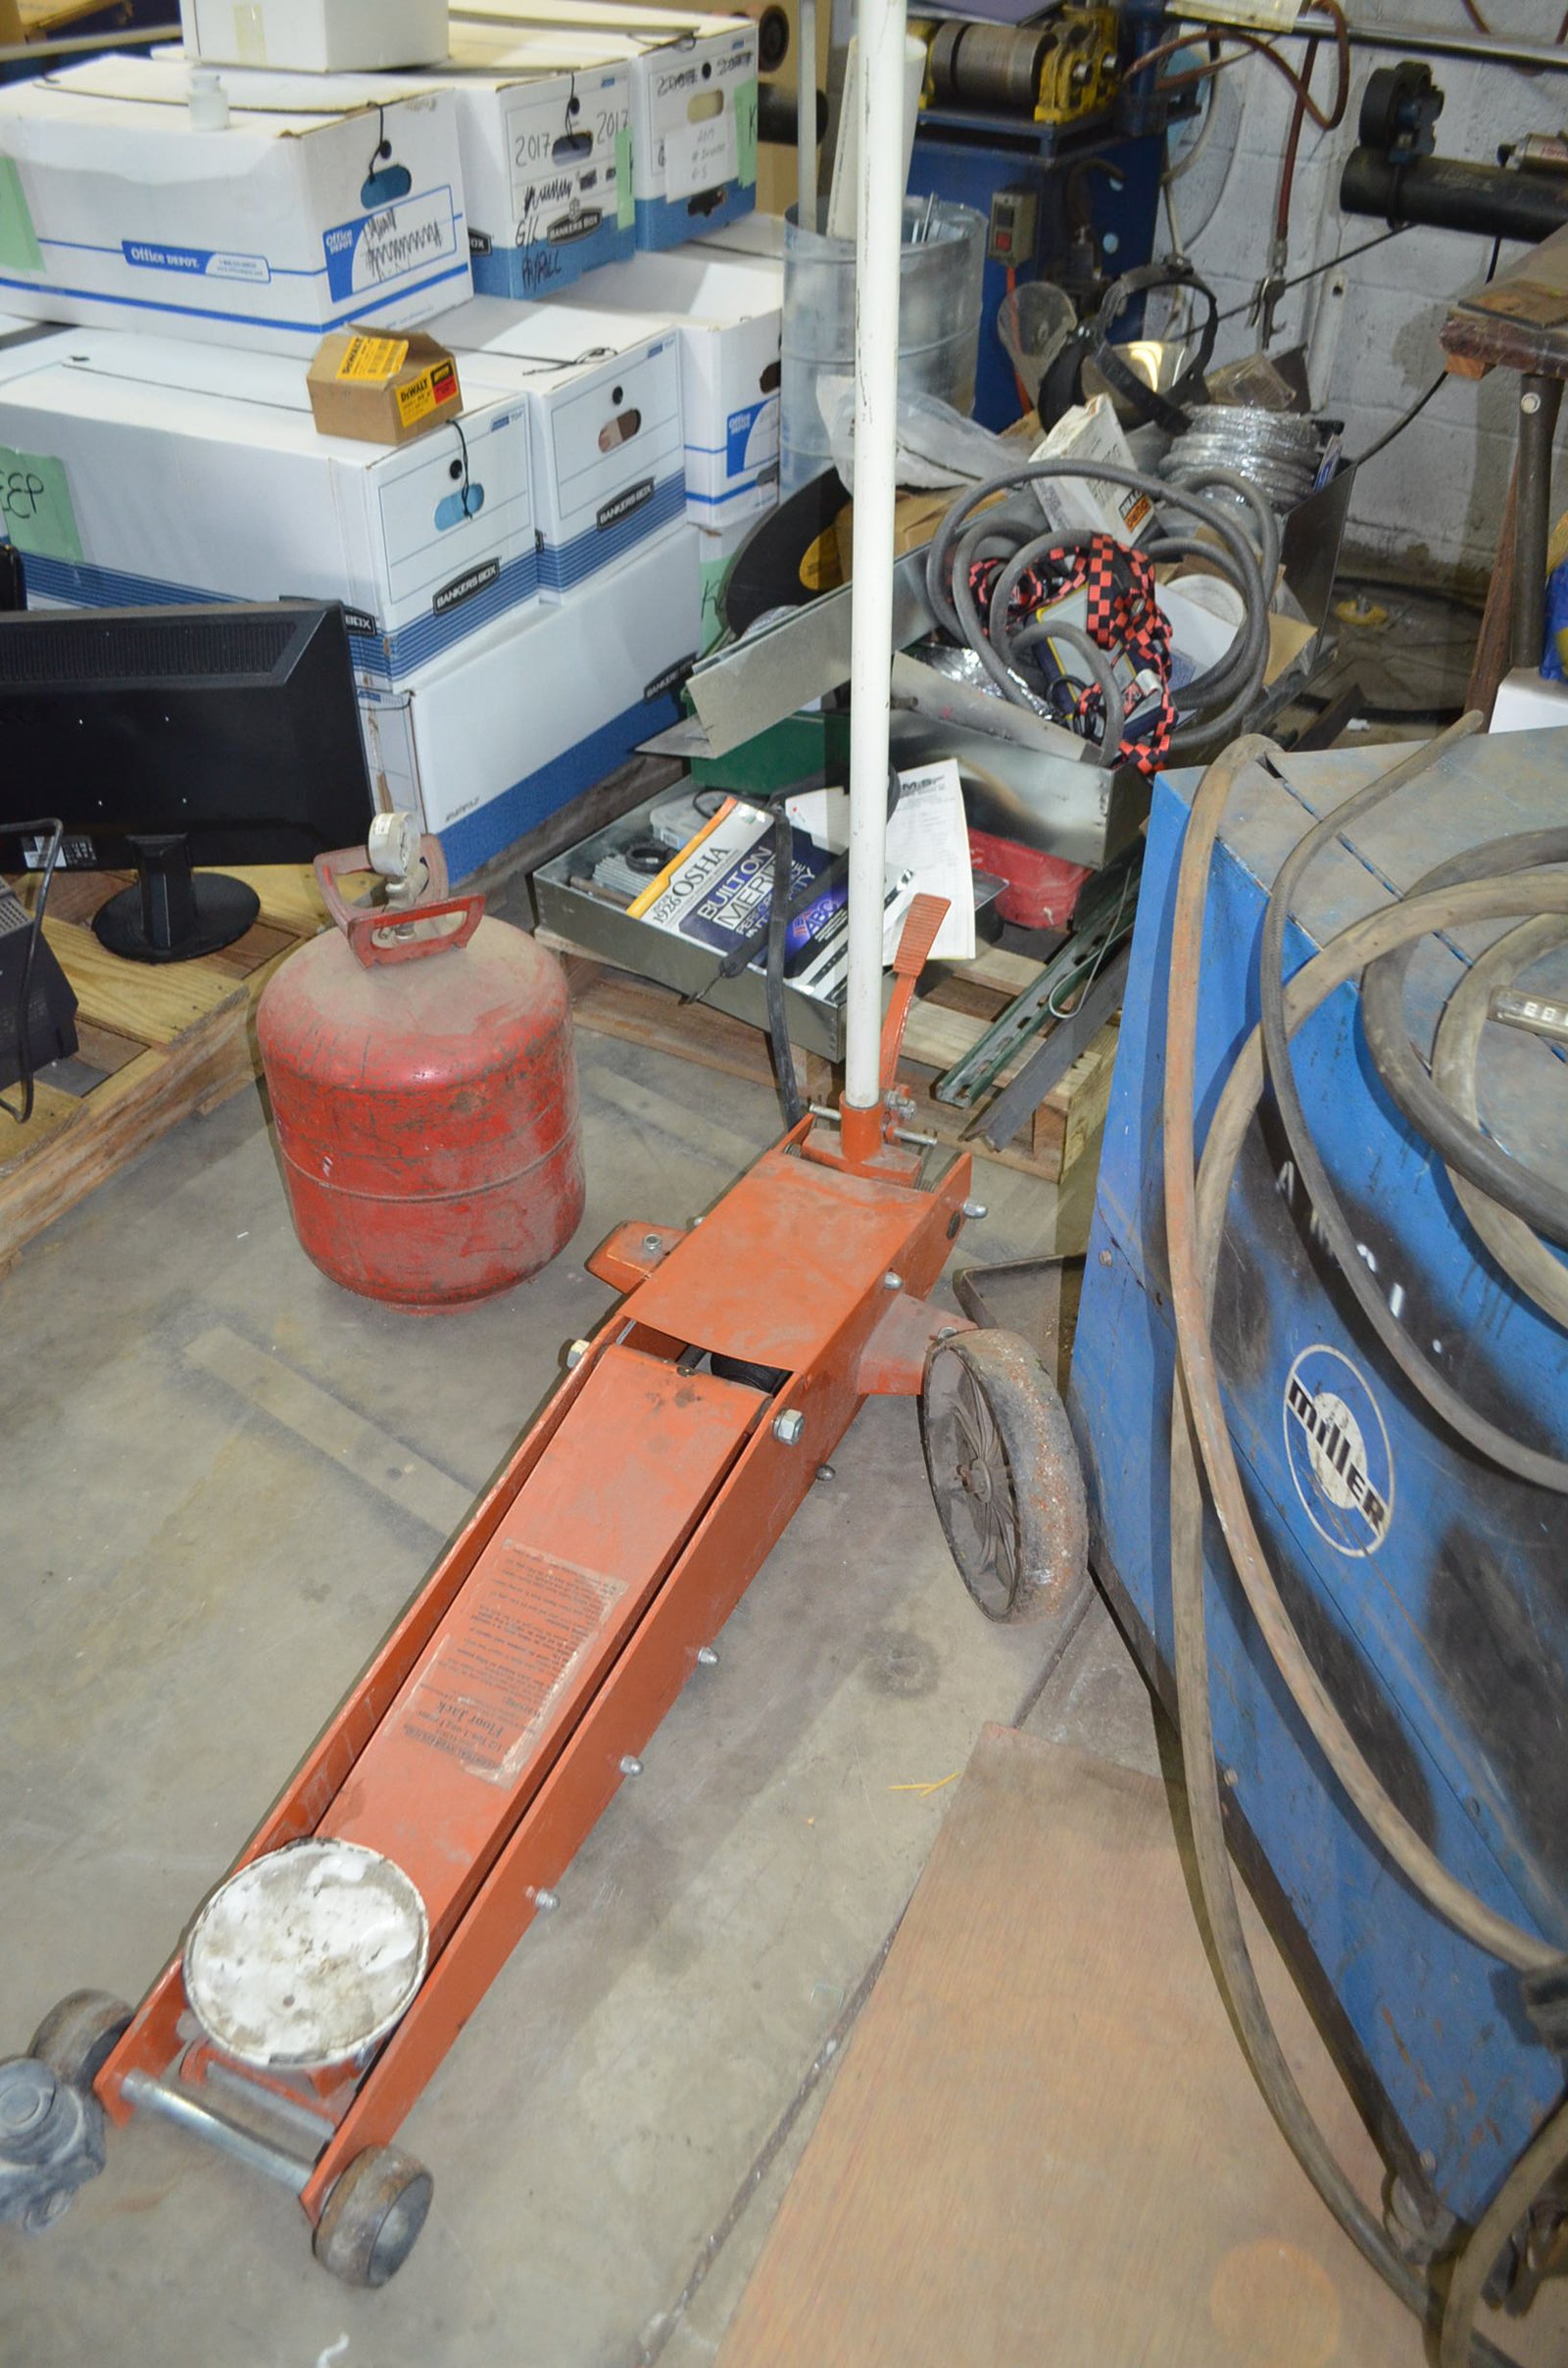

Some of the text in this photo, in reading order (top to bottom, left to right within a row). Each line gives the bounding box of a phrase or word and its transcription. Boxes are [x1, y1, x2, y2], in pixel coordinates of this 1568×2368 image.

[515, 132, 551, 168] 2017
[131, 247, 165, 264] Office
[0, 469, 44, 518] EP
[600, 484, 652, 524] BANKERS BOX
[436, 565, 497, 609] BANKERS BOX
[345, 615, 371, 629] BOX
[653, 896, 682, 924] 1926
[672, 847, 732, 898] OSHA
[697, 870, 741, 919] BUILT
[740, 845, 773, 880] ON
[717, 863, 776, 928] MERI
[806, 898, 836, 937] ABC
